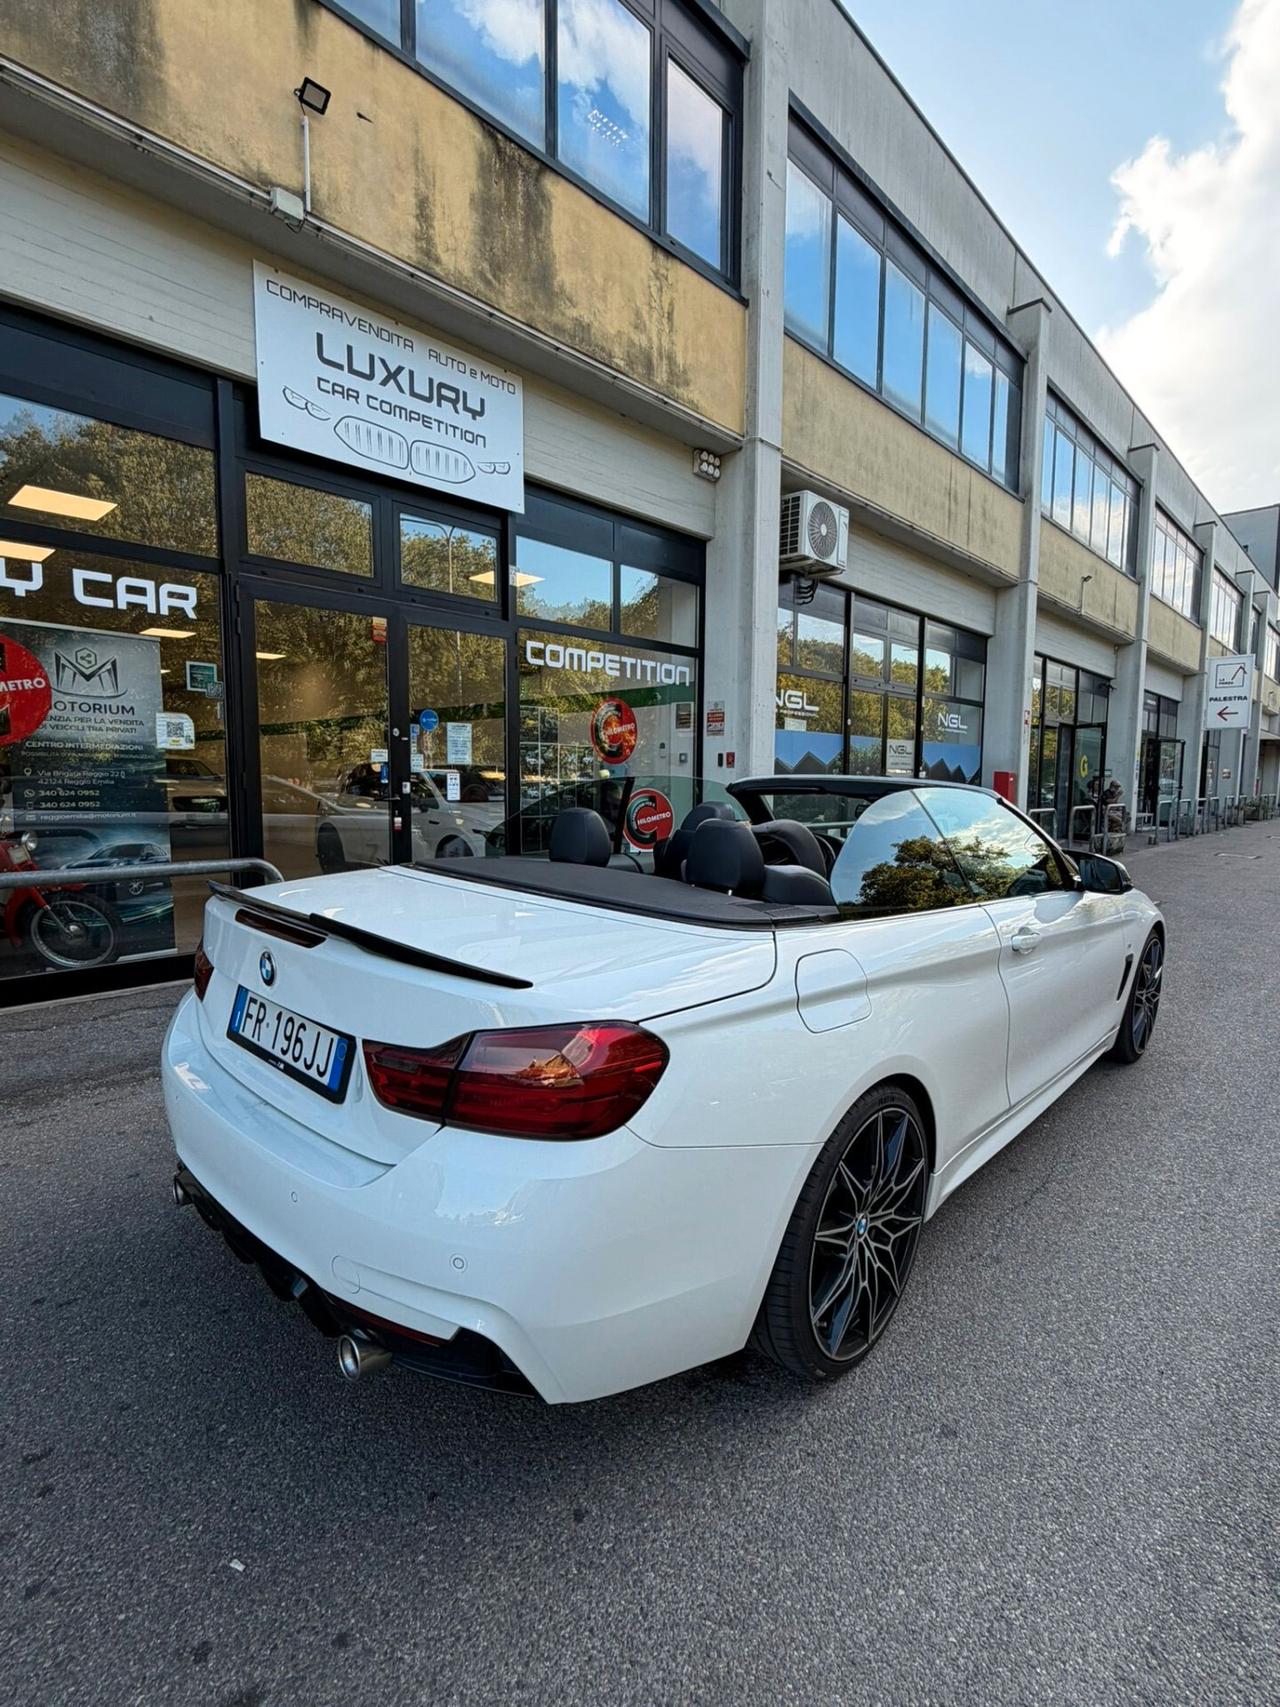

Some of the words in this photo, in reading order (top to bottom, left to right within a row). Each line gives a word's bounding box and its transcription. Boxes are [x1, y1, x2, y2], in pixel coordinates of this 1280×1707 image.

[266, 279, 414, 352] COMPRAVENDITA
[428, 348, 466, 375] AUTO
[469, 368, 478, 378] e
[480, 370, 516, 395] MOTO
[316, 332, 485, 420] LUXURY
[317, 376, 360, 405] CAR
[366, 394, 487, 448] COMPETITION
[72, 568, 197, 620] CAR
[525, 640, 690, 687] COMPETITION
[52, 700, 135, 716] OTORIUM
[74, 716, 92, 724] PER
[937, 712, 968, 729] NGL
[889, 745, 912, 755] NGL
[242, 996, 267, 1042] FR
[272, 1011, 335, 1078] 196JJ
